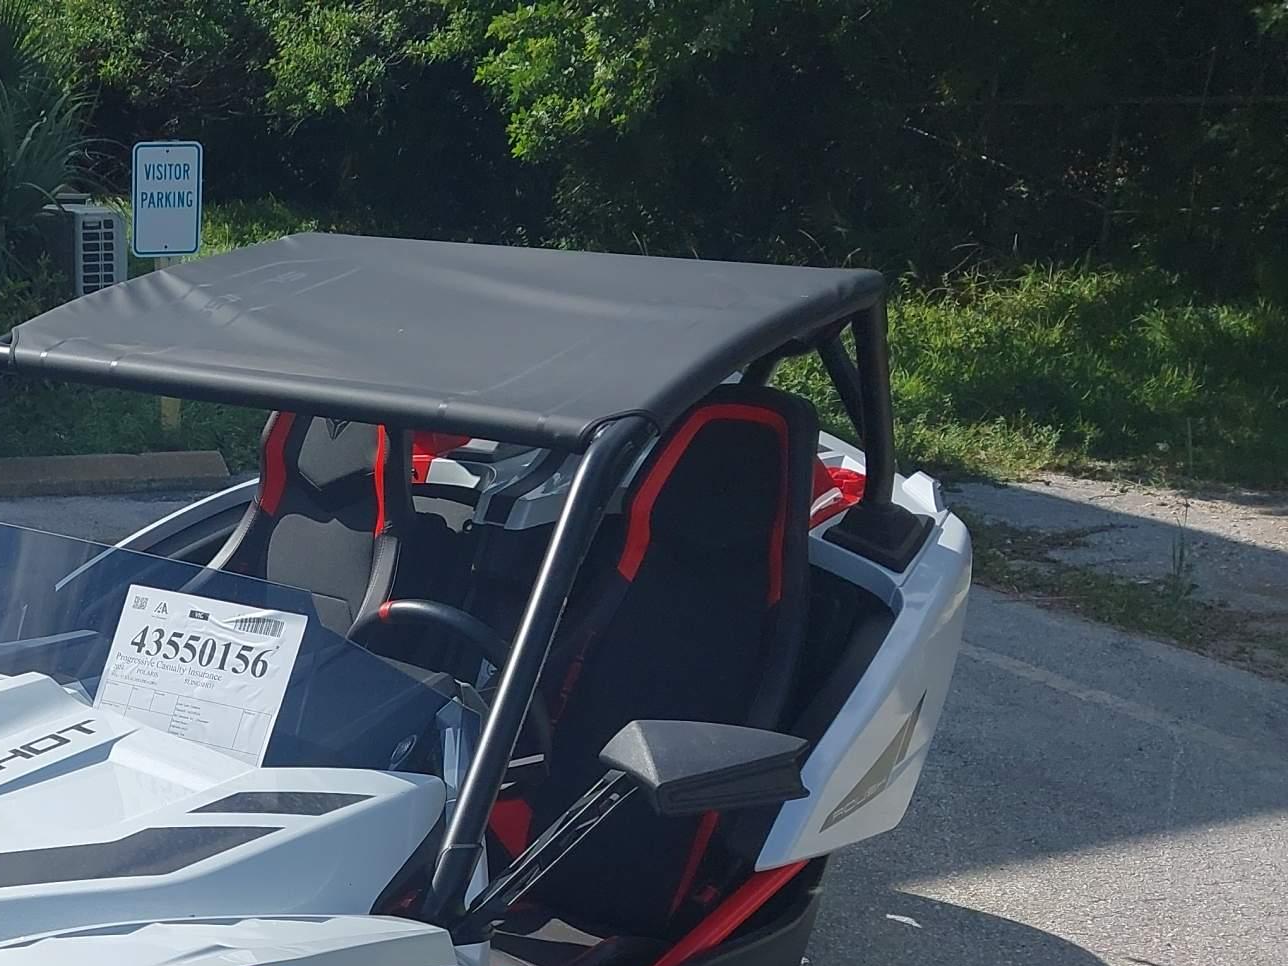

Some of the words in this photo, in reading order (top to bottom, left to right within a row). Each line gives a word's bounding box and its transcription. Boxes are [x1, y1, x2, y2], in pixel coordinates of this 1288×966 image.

[144, 163, 191, 181] VISITOR
[140, 191, 193, 209] PARKING
[130, 625, 273, 678] 43550156
[116, 651, 156, 667] Progressive
[156, 660, 187, 676] Casualty
[188, 666, 223, 681] Insurance
